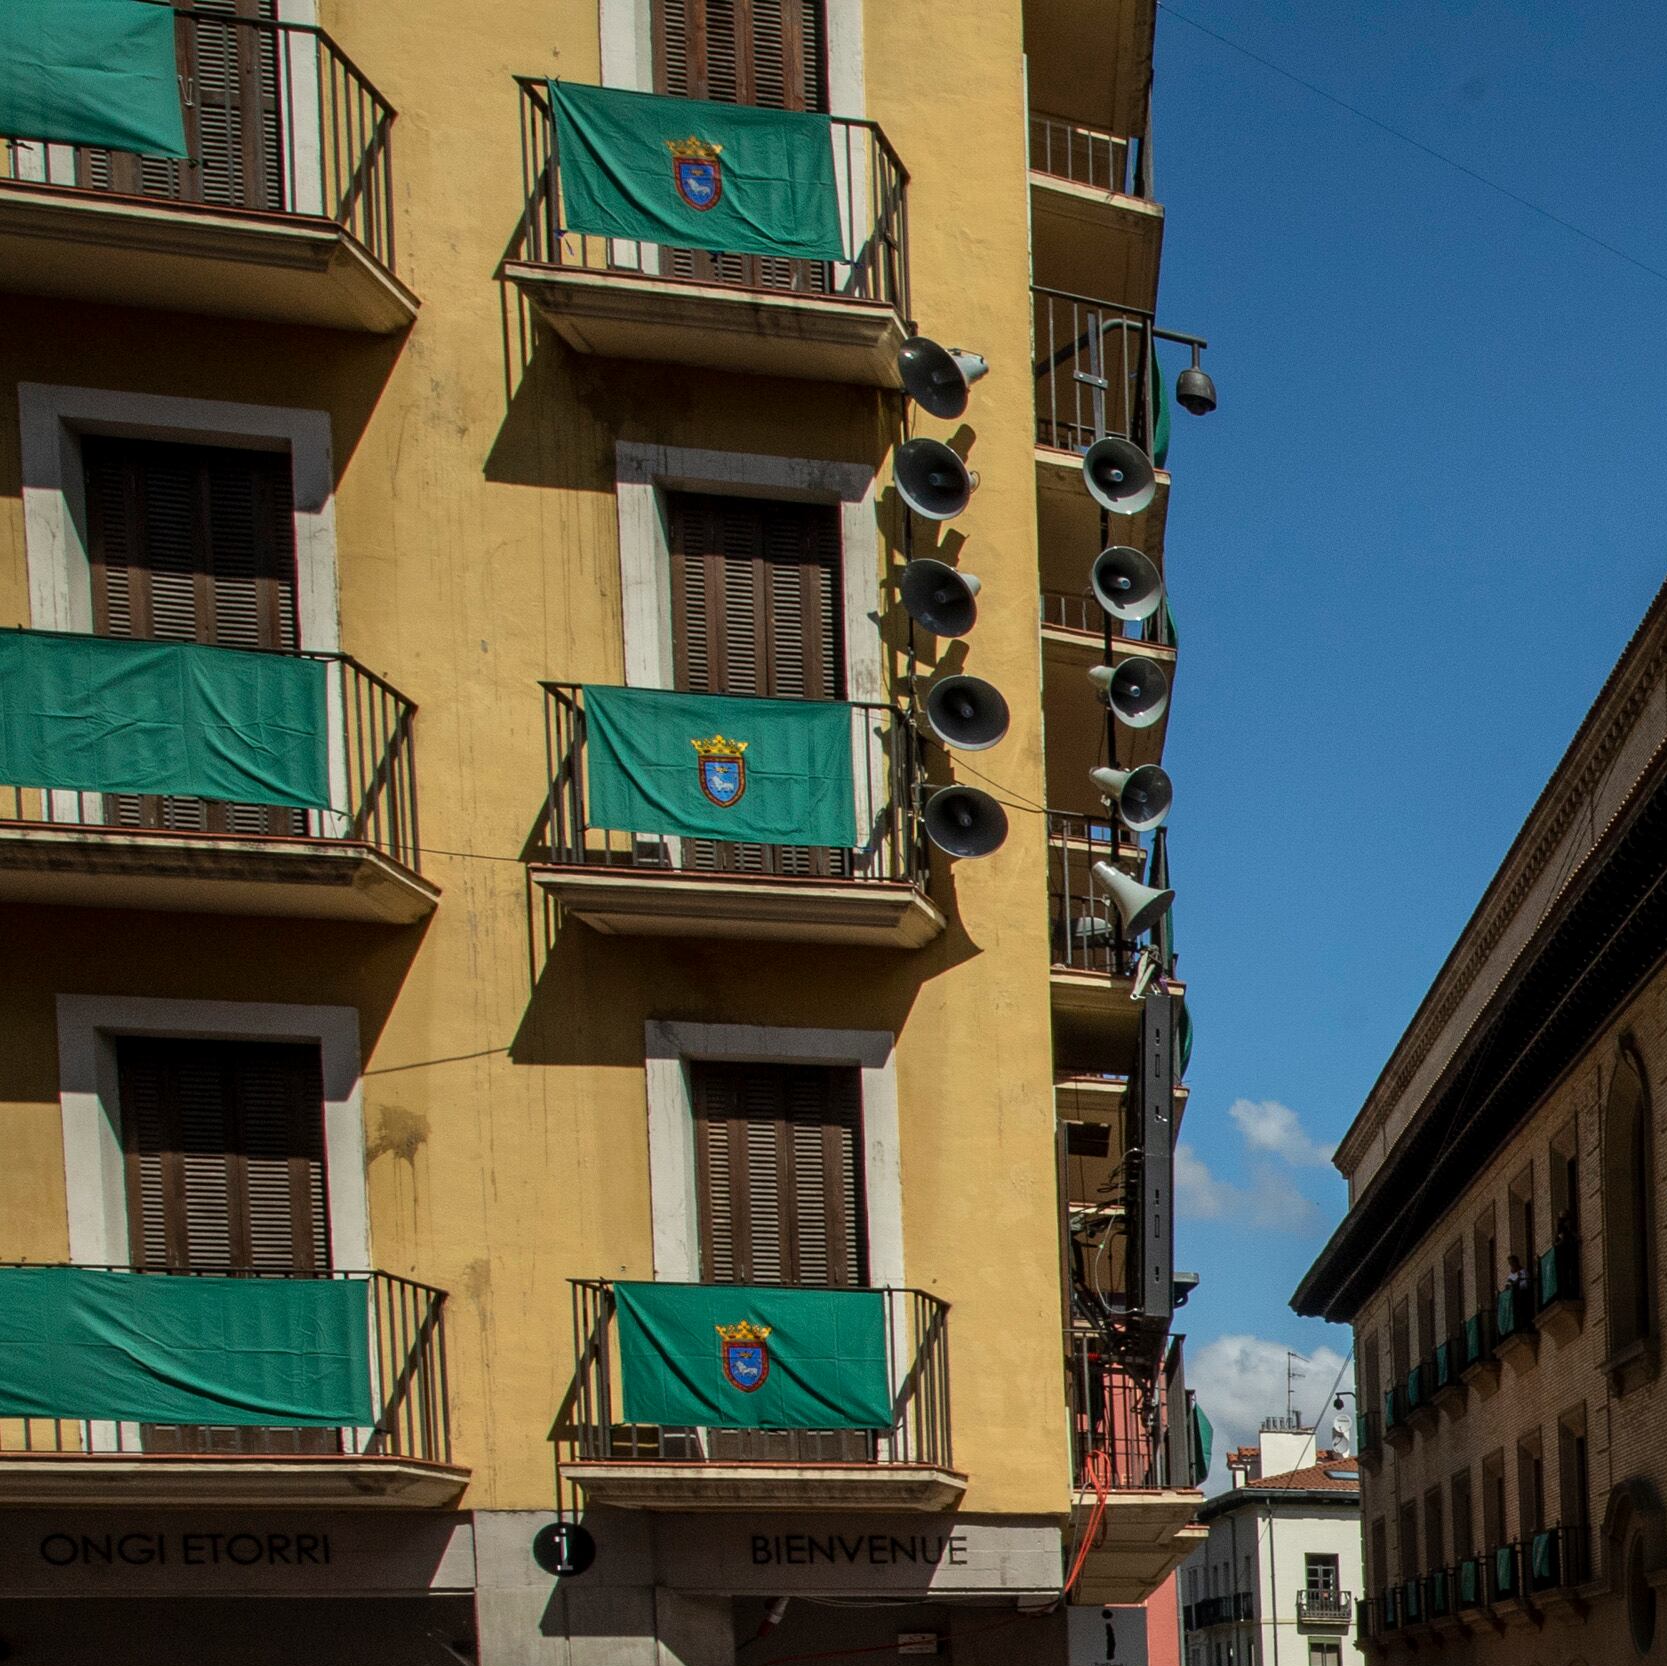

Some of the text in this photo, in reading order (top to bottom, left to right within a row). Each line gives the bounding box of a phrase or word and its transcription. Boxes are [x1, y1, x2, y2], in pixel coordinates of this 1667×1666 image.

[39, 1533, 331, 1566] ONGI ETORRI
[751, 1534, 968, 1566] BIENVENUE
